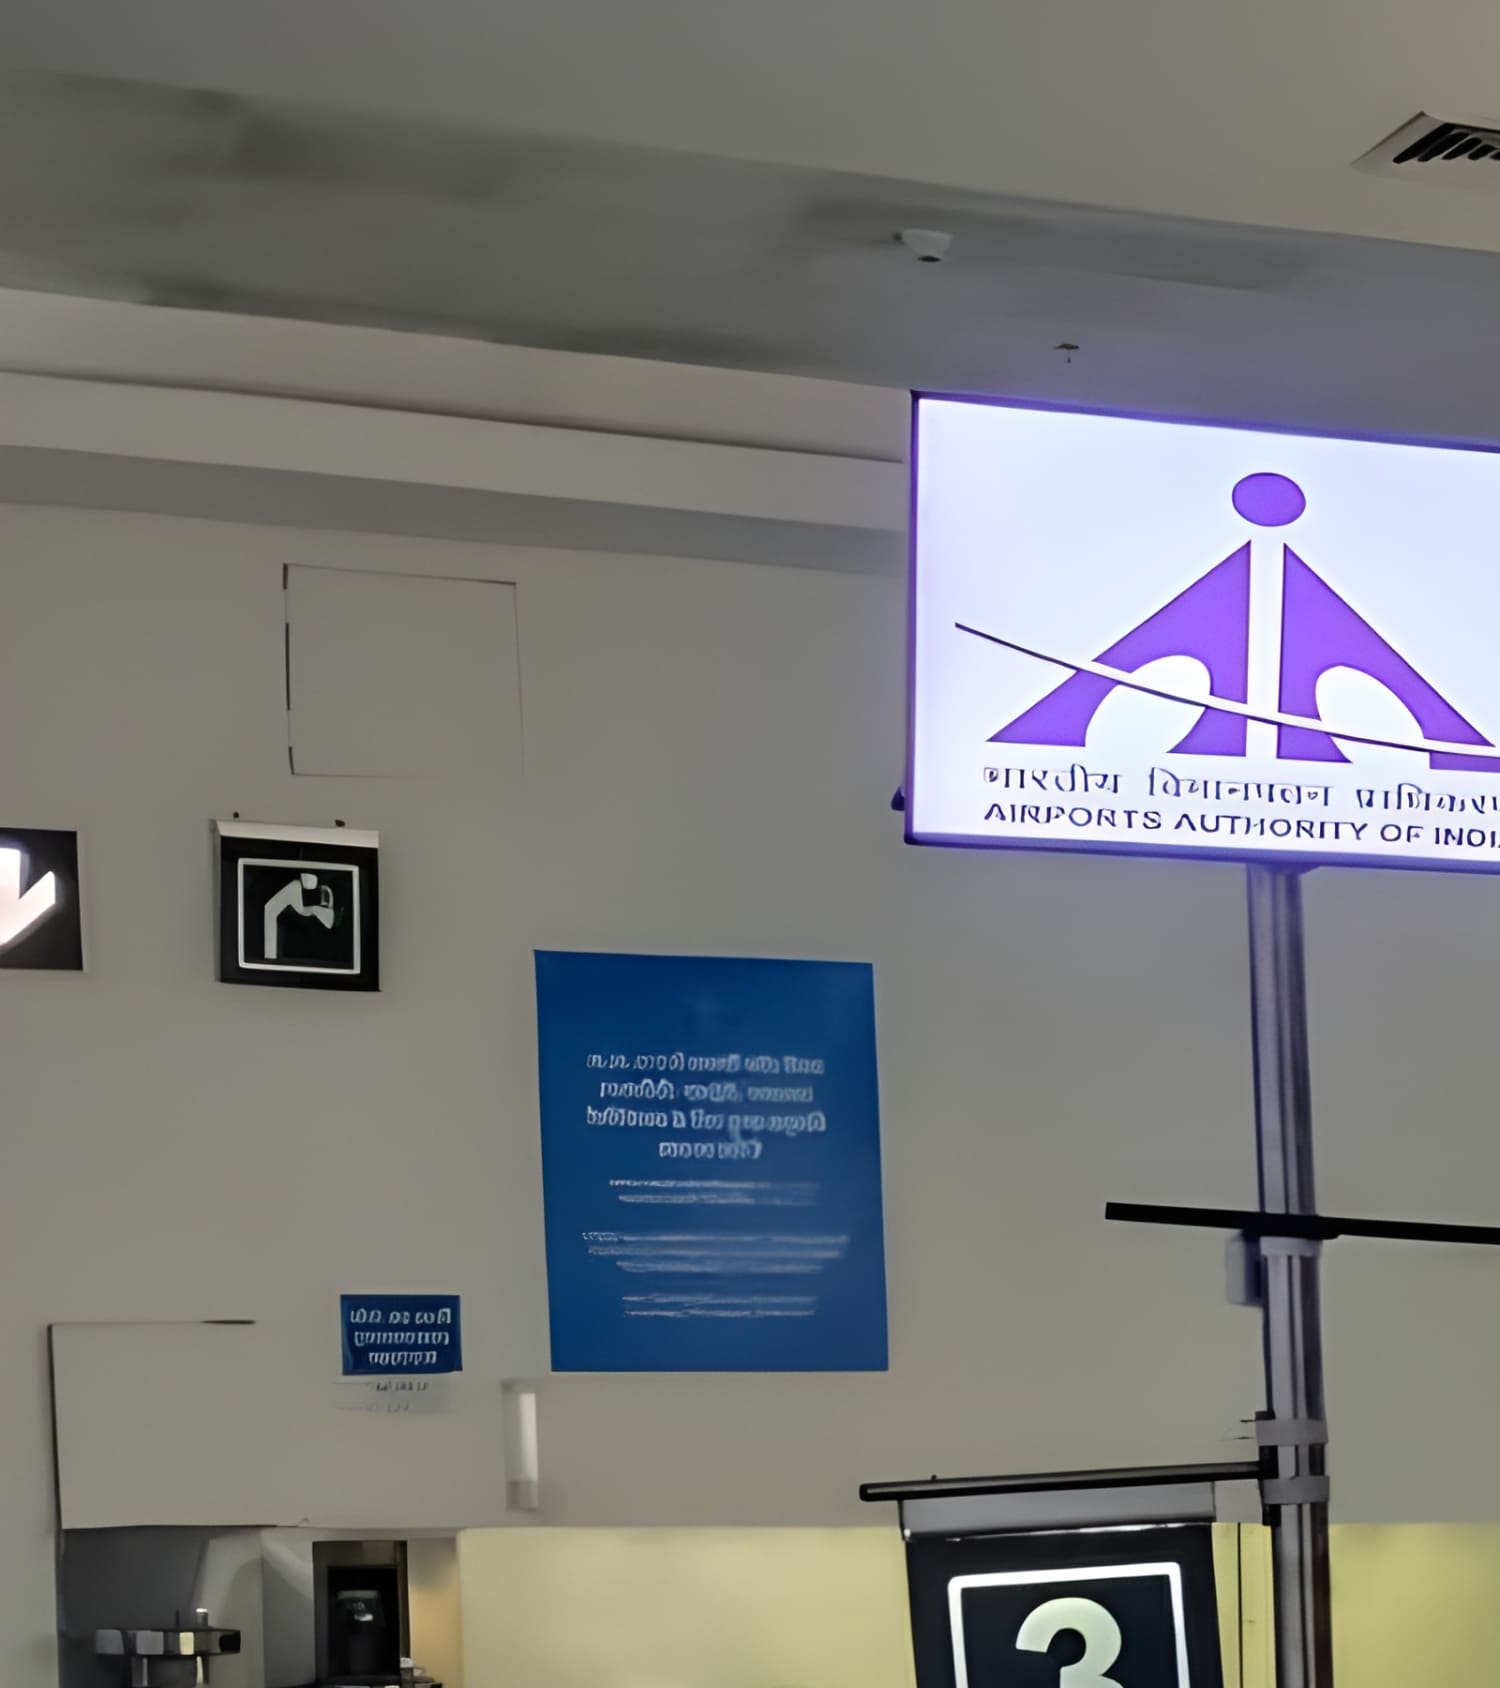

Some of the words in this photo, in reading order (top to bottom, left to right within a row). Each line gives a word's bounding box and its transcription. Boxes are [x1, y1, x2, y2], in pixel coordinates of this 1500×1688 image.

[984, 804, 1161, 830] AIRPORTS
[1174, 813, 1369, 842] AUTHORITY
[1380, 823, 1424, 843] OF
